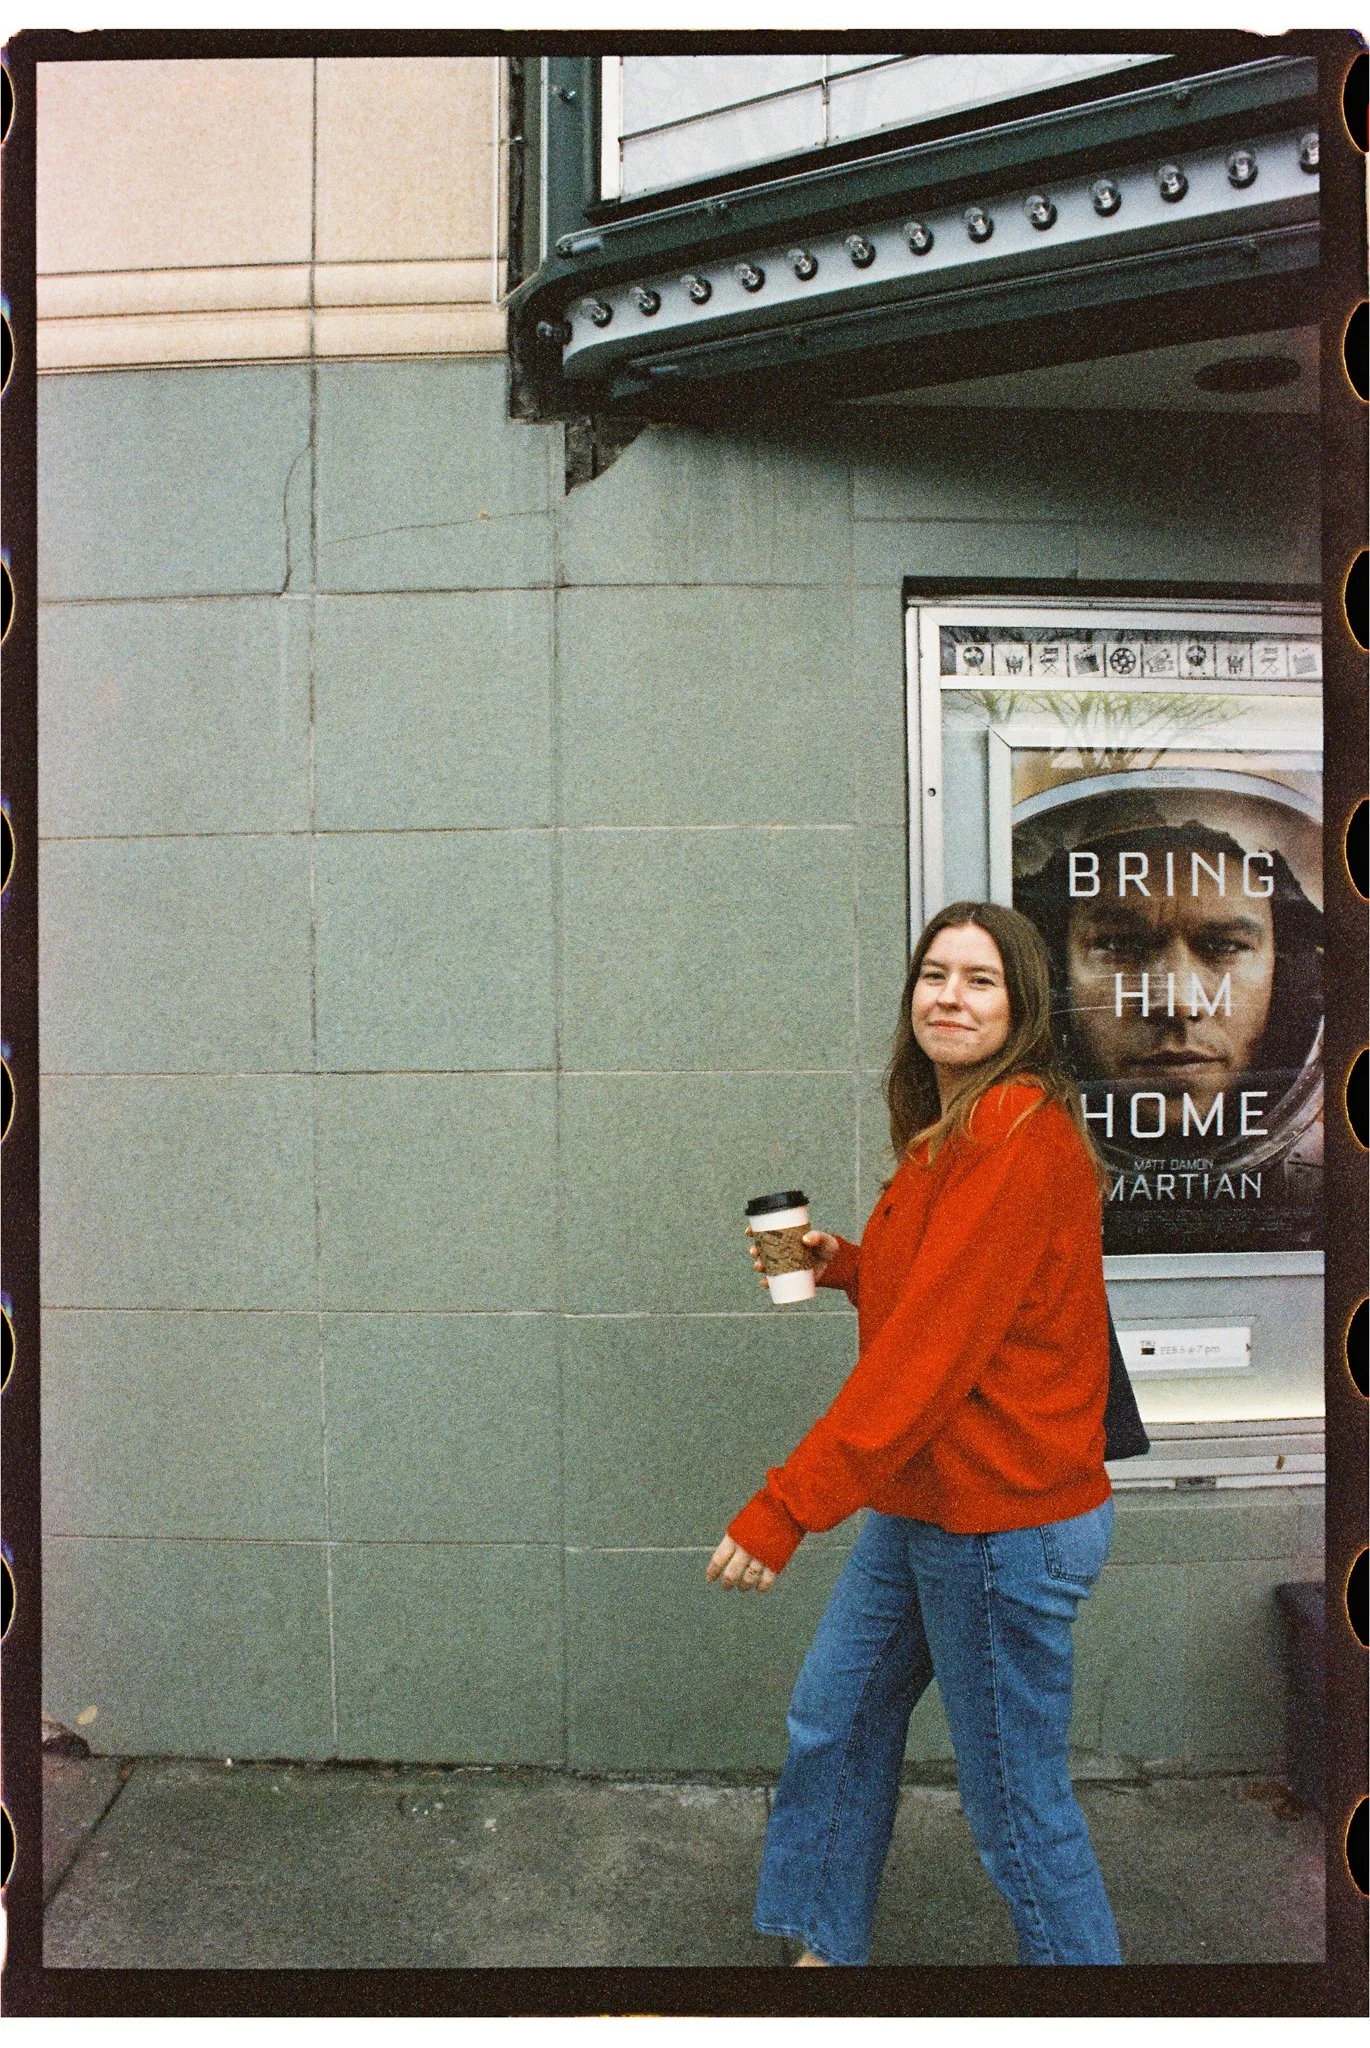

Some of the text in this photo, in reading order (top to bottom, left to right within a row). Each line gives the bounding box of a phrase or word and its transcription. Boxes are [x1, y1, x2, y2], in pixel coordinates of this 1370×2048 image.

[1069, 851, 1275, 898] BRING
[1115, 972, 1232, 1018] HIM
[1080, 1090, 1269, 1139] HOME
[1134, 1158, 1214, 1171] MATT DAMON
